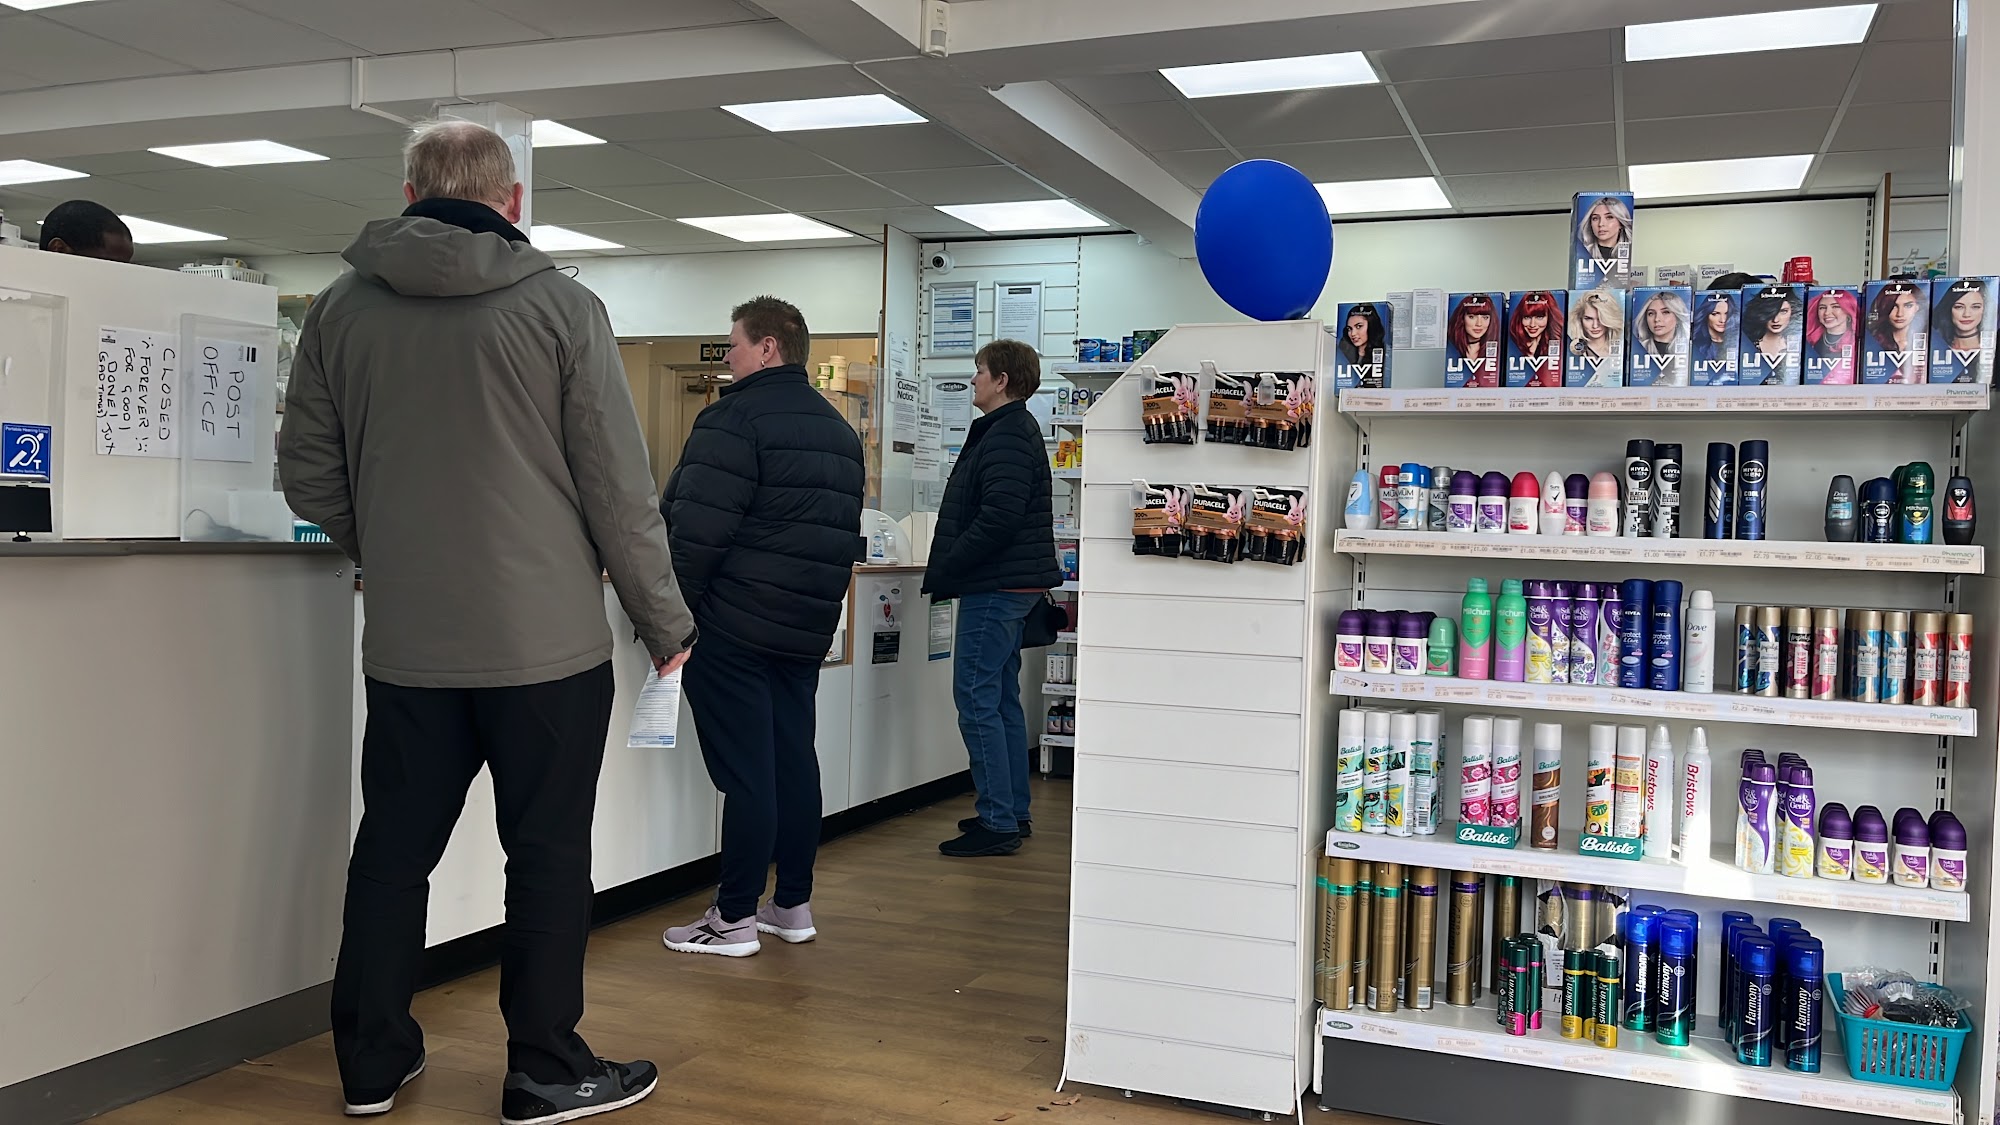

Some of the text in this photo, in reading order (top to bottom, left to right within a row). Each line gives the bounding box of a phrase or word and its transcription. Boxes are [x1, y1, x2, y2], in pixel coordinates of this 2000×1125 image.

[1578, 259, 1629, 275] LIVE
[1658, 270, 1686, 278] Complan
[124, 347, 136, 373] FOR
[703, 347, 731, 358] EXIT
[1866, 350, 1926, 369] LIVE
[1933, 349, 1995, 367] LIVE
[1447, 358, 1497, 373] LIVE
[1509, 356, 1560, 372] LIVE
[1633, 355, 1686, 371] LIVE
[1694, 360, 1736, 373] LIVE
[1742, 352, 1799, 370] LIVE
[1807, 358, 1852, 371] LIVE
[1337, 364, 1383, 379] LIVE
[158, 347, 176, 441] CLOSED
[201, 346, 219, 436] OFFICE
[897, 391, 914, 402] Notice
[1212, 388, 1244, 396] DURACELL
[1254, 388, 1288, 396] DCELL
[226, 370, 245, 439] POST
[1193, 499, 1226, 509] DURACELL
[1254, 500, 1287, 511] DURACELL
[1463, 608, 1491, 616] Mitchum
[1497, 609, 1525, 617] Mitchum
[1530, 612, 1550, 620] Gentle
[1687, 623, 1707, 632] Dove
[1930, 712, 1963, 721] Pharmacy
[1462, 754, 1484, 764] Batiste
[1789, 802, 1812, 811] Gentle
[1459, 827, 1510, 845] Batiste
[1580, 837, 1636, 855] Batiste
[1635, 951, 1650, 994] Harmony
[1660, 962, 1673, 1006] Harmony
[1565, 982, 1573, 1015] silvikrin
[1745, 981, 1761, 1026] Harmony
[1795, 987, 1811, 1032] Harmony
